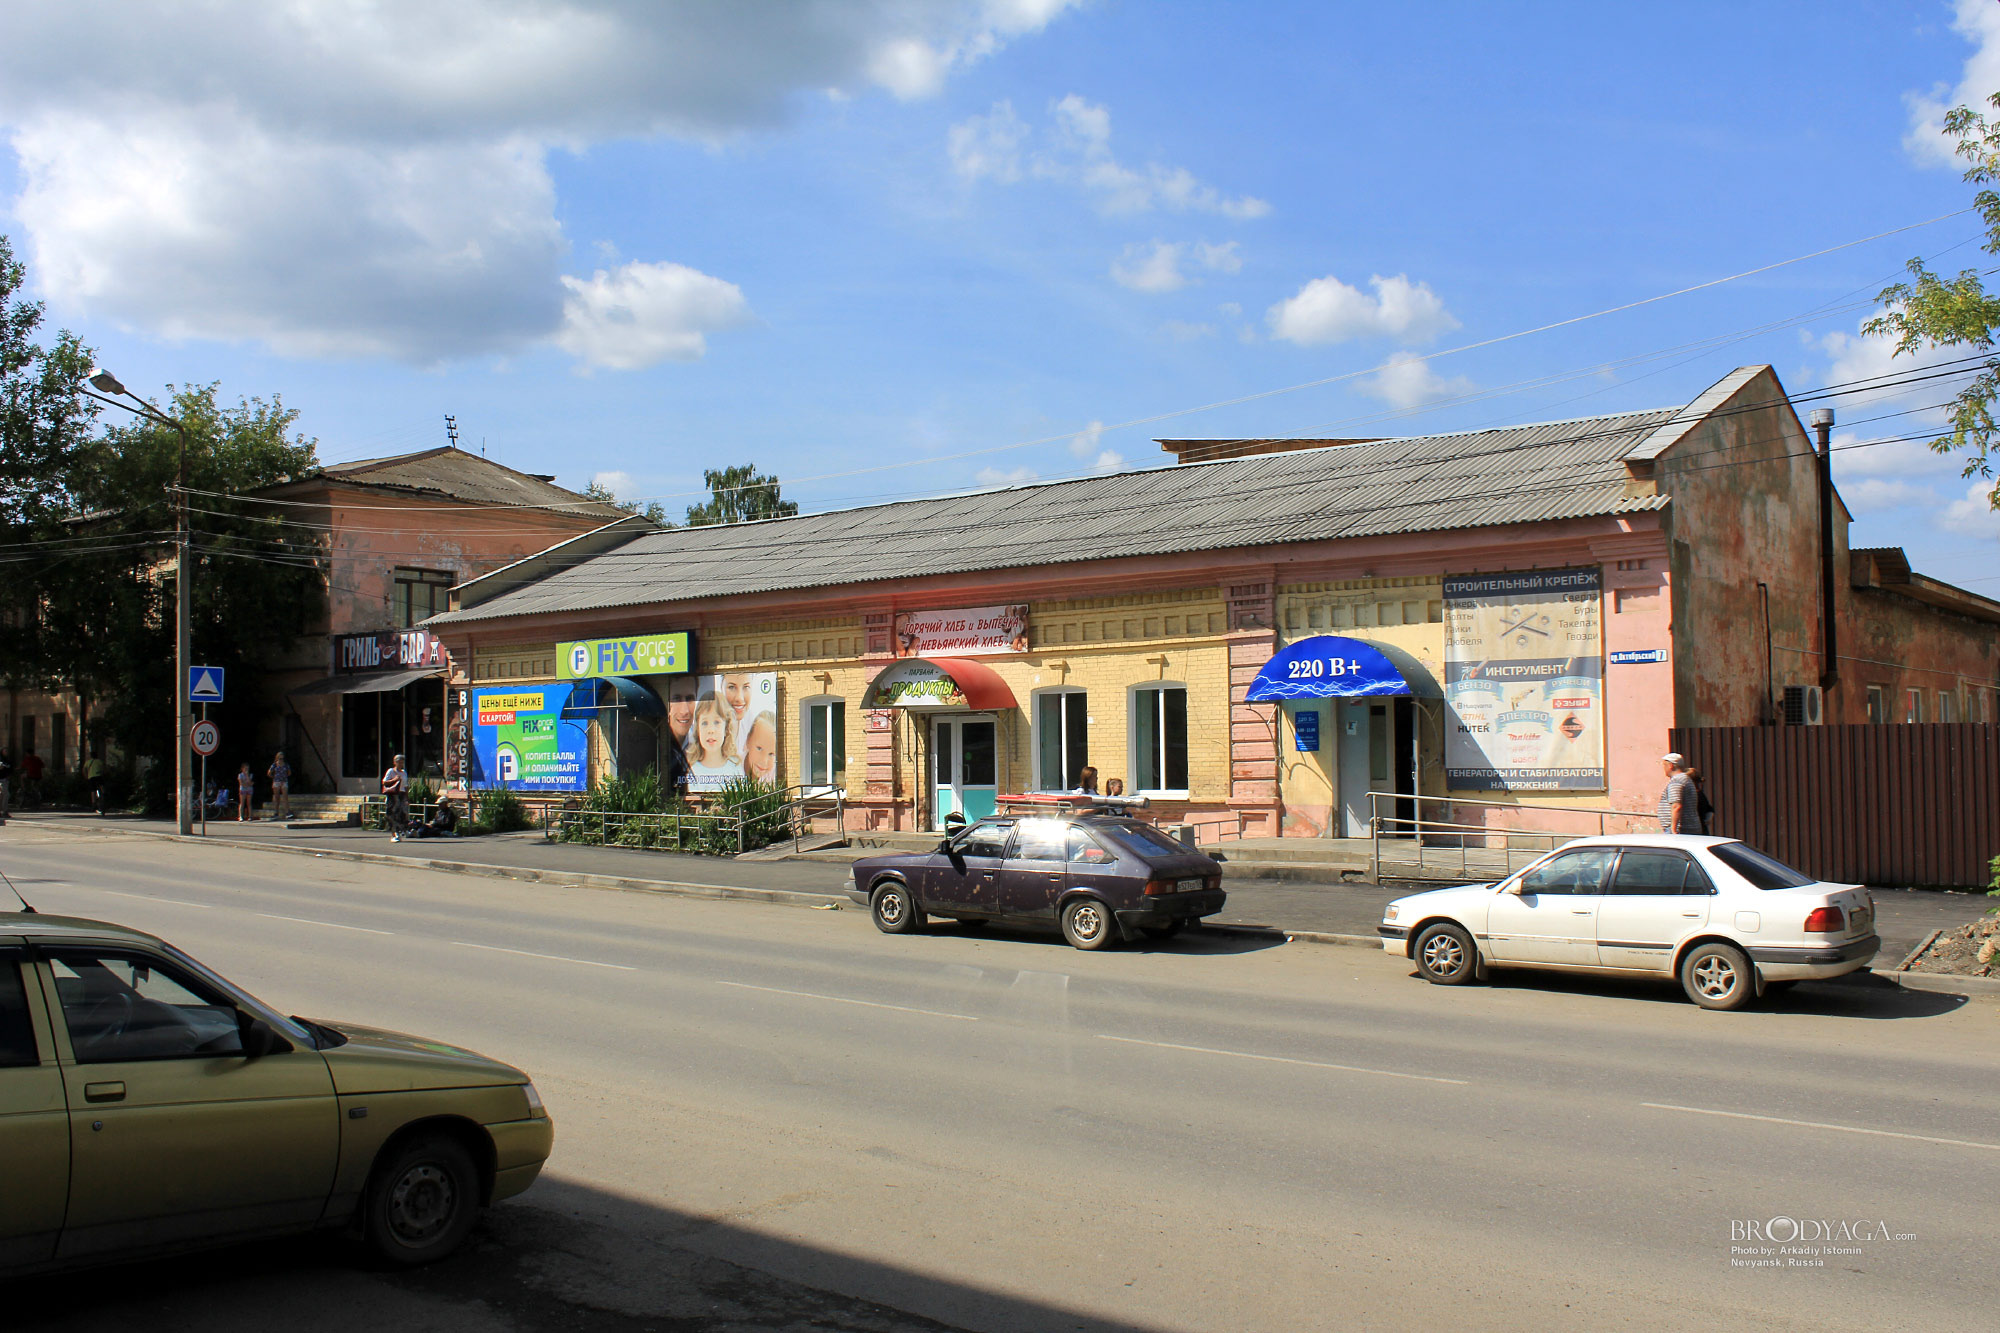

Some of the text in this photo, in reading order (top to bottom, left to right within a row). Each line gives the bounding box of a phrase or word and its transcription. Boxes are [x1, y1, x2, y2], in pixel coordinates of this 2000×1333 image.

[1444, 572, 1598, 592] СТРОИТЕЛЬНЫЙ КРЕПЁЖ
[1562, 593, 1598, 602] Сверла
[1574, 606, 1598, 615] Буры
[1445, 613, 1474, 621] Болты
[904, 619, 943, 635] ГОРЯЧИЙ
[944, 619, 966, 632] ХЛЕБ
[977, 616, 1019, 630] ВЫПЕЧКА
[1446, 625, 1471, 633] Гайки
[1558, 619, 1598, 629] Такелаж
[1445, 637, 1482, 647] Дюбеля
[1566, 632, 1598, 642] Гвозди
[342, 632, 424, 668] ГРИЛЬ БАР
[638, 640, 676, 661] price
[1658, 650, 1664, 660] 7
[1288, 659, 1323, 679] 220
[1485, 664, 1564, 676] ИНСТРУМЕНТ
[1457, 680, 1492, 691] БЕНЗО
[1551, 677, 1591, 688] РУЧНОЙ
[890, 680, 955, 697] ПРОДУКТЫ
[481, 696, 542, 709] ЦЕНЫ ЕЩЁ НИЖЕ
[1562, 699, 1589, 707] ЗУБР
[486, 713, 514, 722] КАРТОЙ!
[1461, 713, 1488, 721] STIHL
[1498, 711, 1549, 724] ЭЛЕКТРО
[199, 731, 214, 745] 20
[459, 690, 468, 791] BURGER
[525, 751, 576, 760] КОПИТЕ БАЛЛЫ
[525, 762, 580, 772] И ОПЛАЧИВАЙТЕ
[1448, 769, 1604, 778] ГЕНЕРАТОРЫ И СТАБИЛИЗАТОРЫ
[525, 775, 577, 784] ИМИ ПОКУПКИ!
[1490, 781, 1559, 789] НАПРЯЖЕНИЯ
